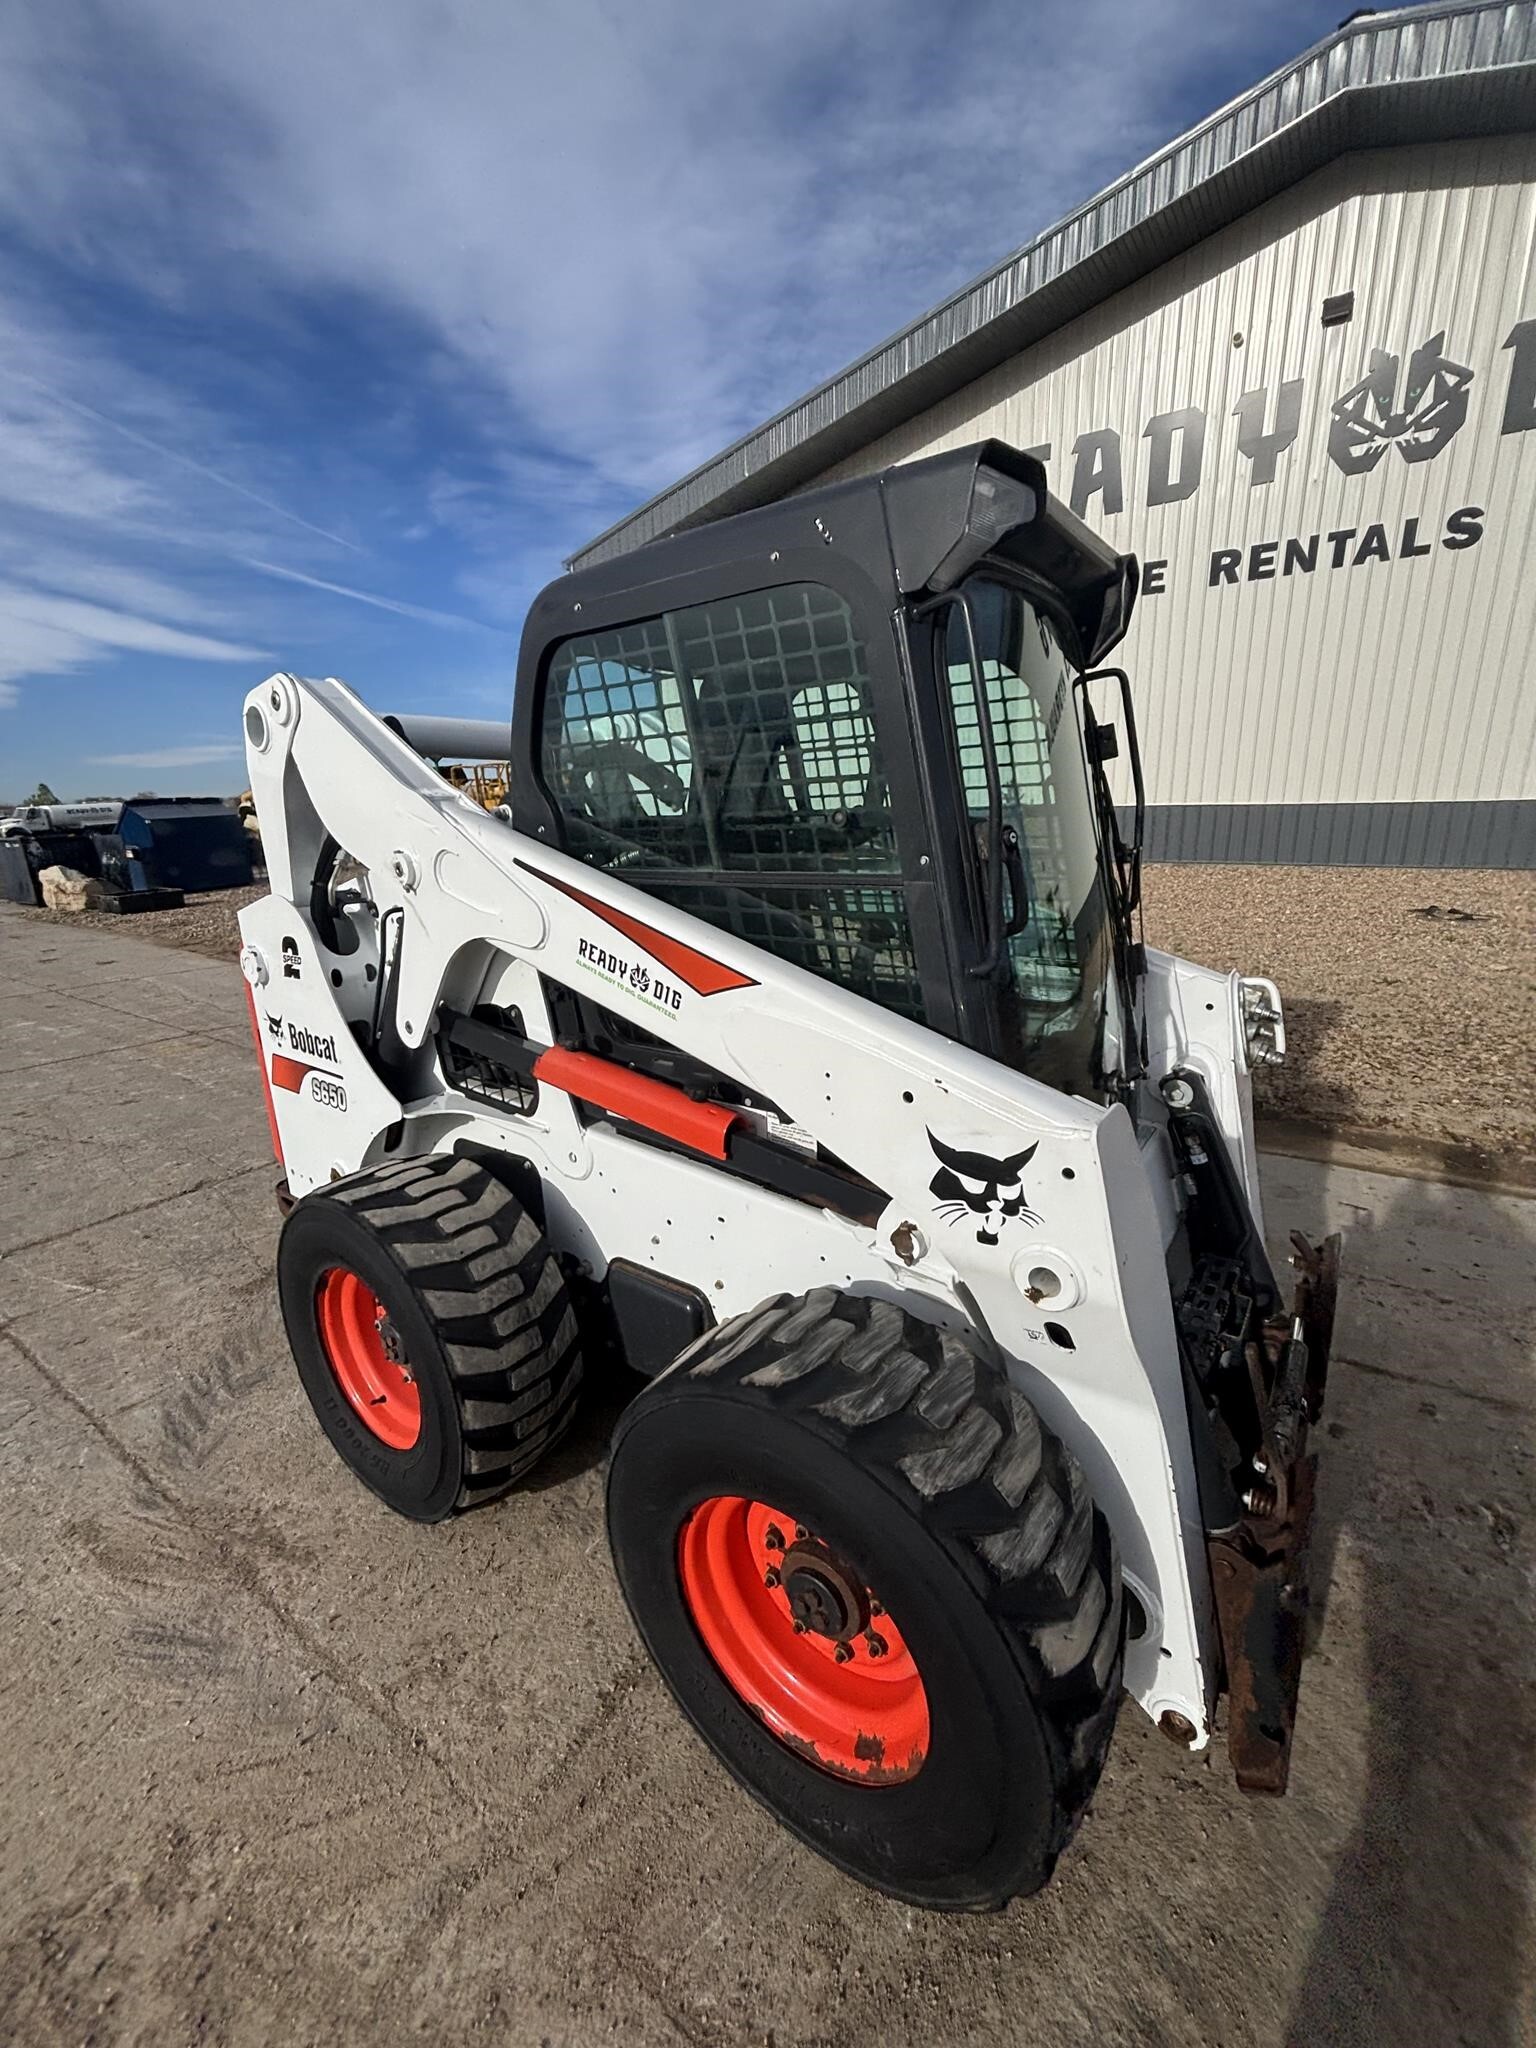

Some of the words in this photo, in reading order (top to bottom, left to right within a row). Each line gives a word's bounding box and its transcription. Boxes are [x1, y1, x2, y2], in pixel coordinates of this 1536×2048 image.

[1021, 378, 1304, 520] ADY
[1208, 506, 1485, 587] RENTALS
[282, 954, 302, 965] SPEED
[576, 959, 597, 975] ALWAYS
[598, 970, 617, 985] READY
[617, 982, 625, 991] TO
[579, 938, 628, 979] READY
[653, 980, 682, 1010] DIG
[288, 1022, 338, 1064] Bobcat
[311, 1077, 347, 1113] S650
